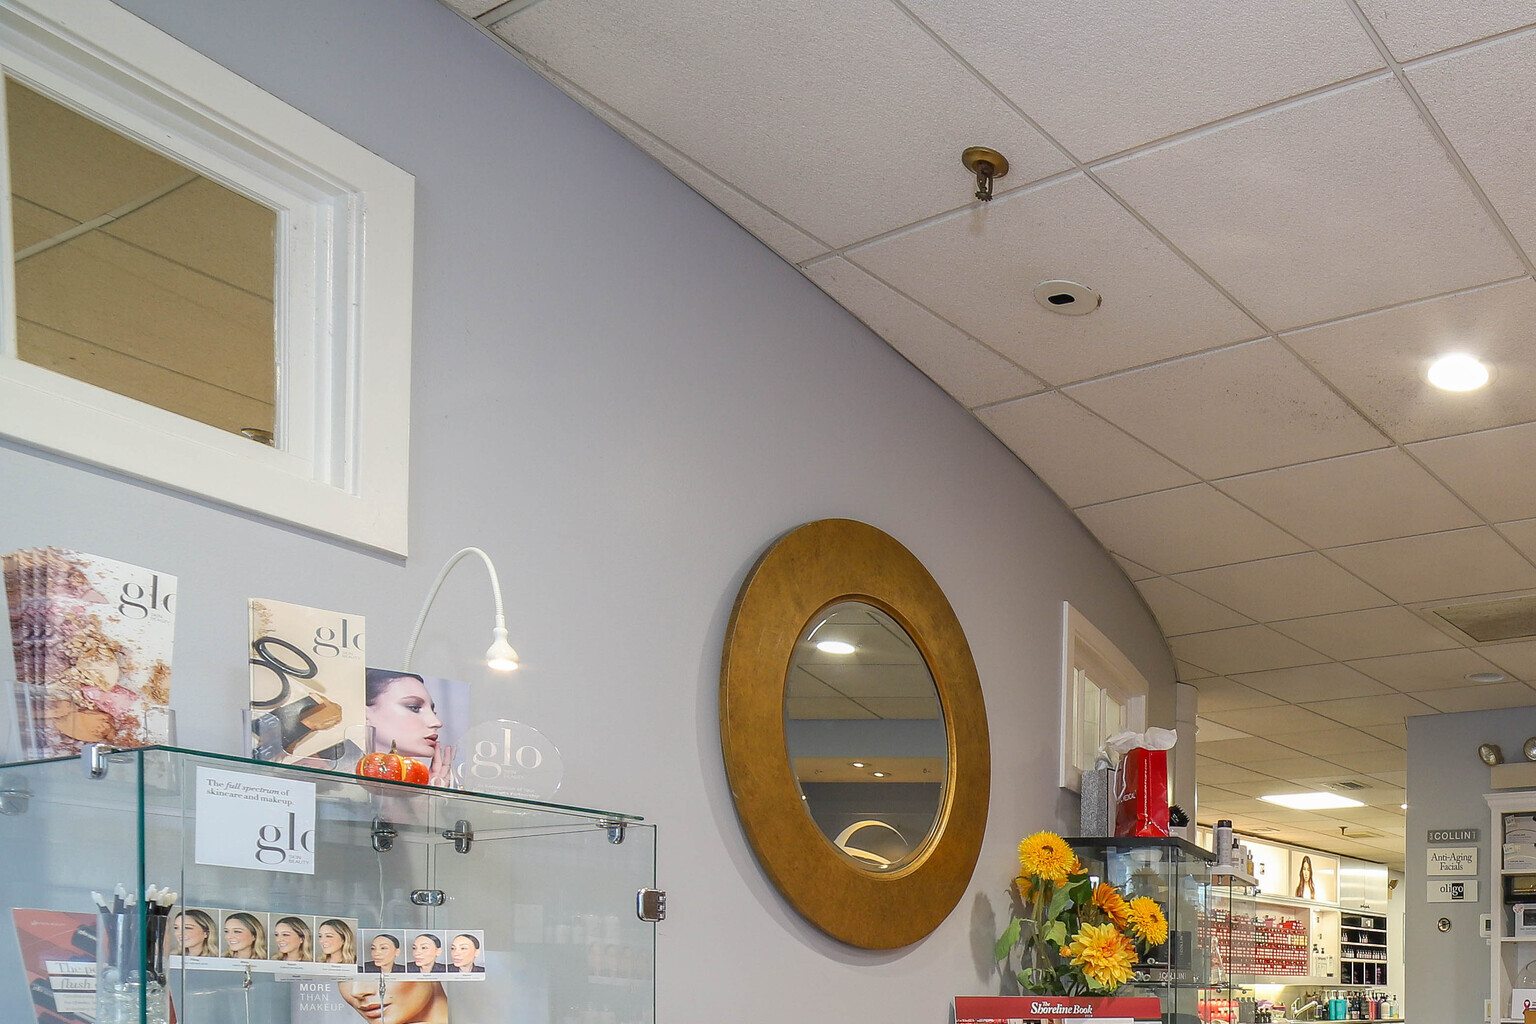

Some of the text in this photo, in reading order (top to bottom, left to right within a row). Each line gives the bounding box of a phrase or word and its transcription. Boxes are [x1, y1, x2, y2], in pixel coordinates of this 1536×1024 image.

[471, 728, 542, 780] glo
[206, 779, 224, 788] The
[224, 781, 241, 790] full
[242, 786, 280, 796] spectrum
[206, 788, 295, 807] skincare and makeup.
[1434, 832, 1471, 840] COLLIN
[1431, 853, 1473, 863] Anti-Aging
[1440, 862, 1464, 871] Facials
[1440, 884, 1464, 896] oligo
[55, 962, 82, 974] The
[60, 976, 91, 989] flush
[299, 983, 331, 992] MORE
[299, 993, 329, 1001] THAN
[299, 1003, 345, 1012] MAKEUP
[1030, 1002, 1093, 1014] Shoreline Book
